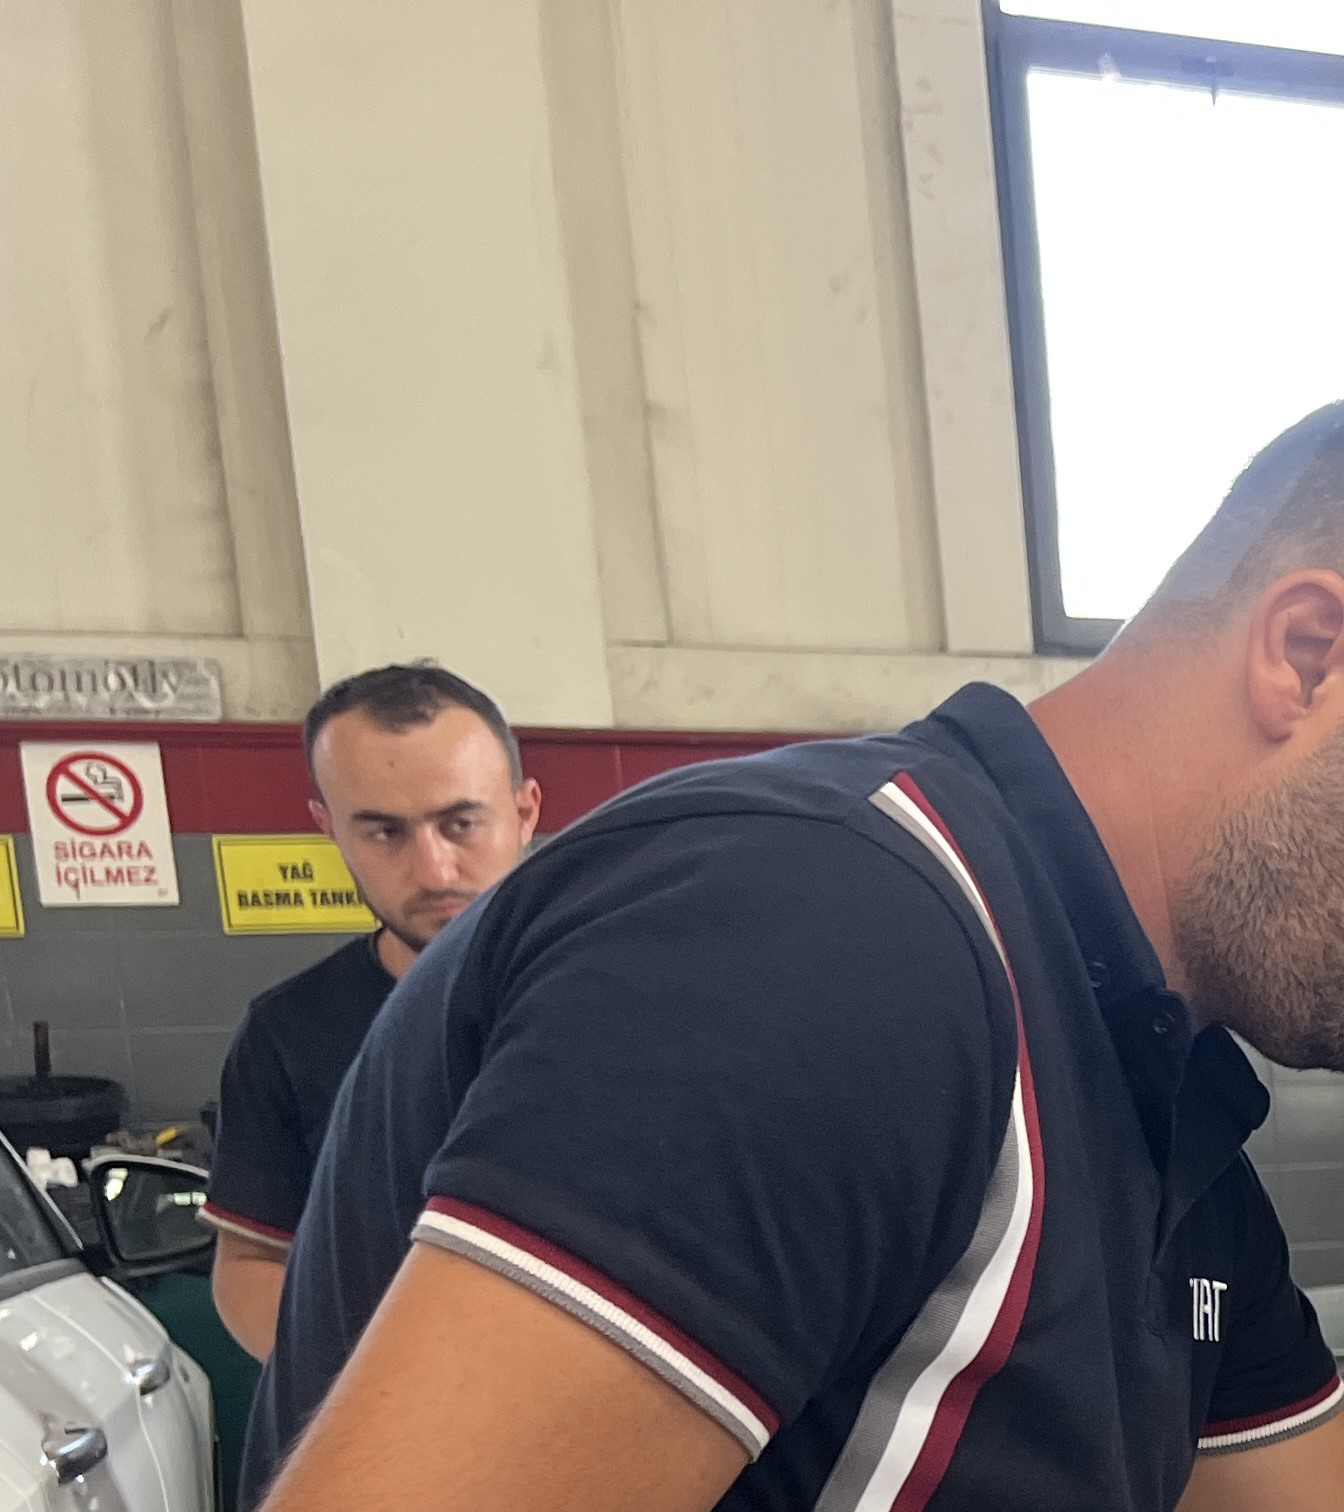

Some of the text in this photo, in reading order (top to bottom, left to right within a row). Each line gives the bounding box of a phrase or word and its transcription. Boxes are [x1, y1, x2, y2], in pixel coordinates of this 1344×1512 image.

[54, 838, 153, 862] SİGARA
[55, 863, 159, 897] İÇİLMEZ
[237, 889, 304, 909] BASMA
[1189, 1278, 1228, 1342] IAT
